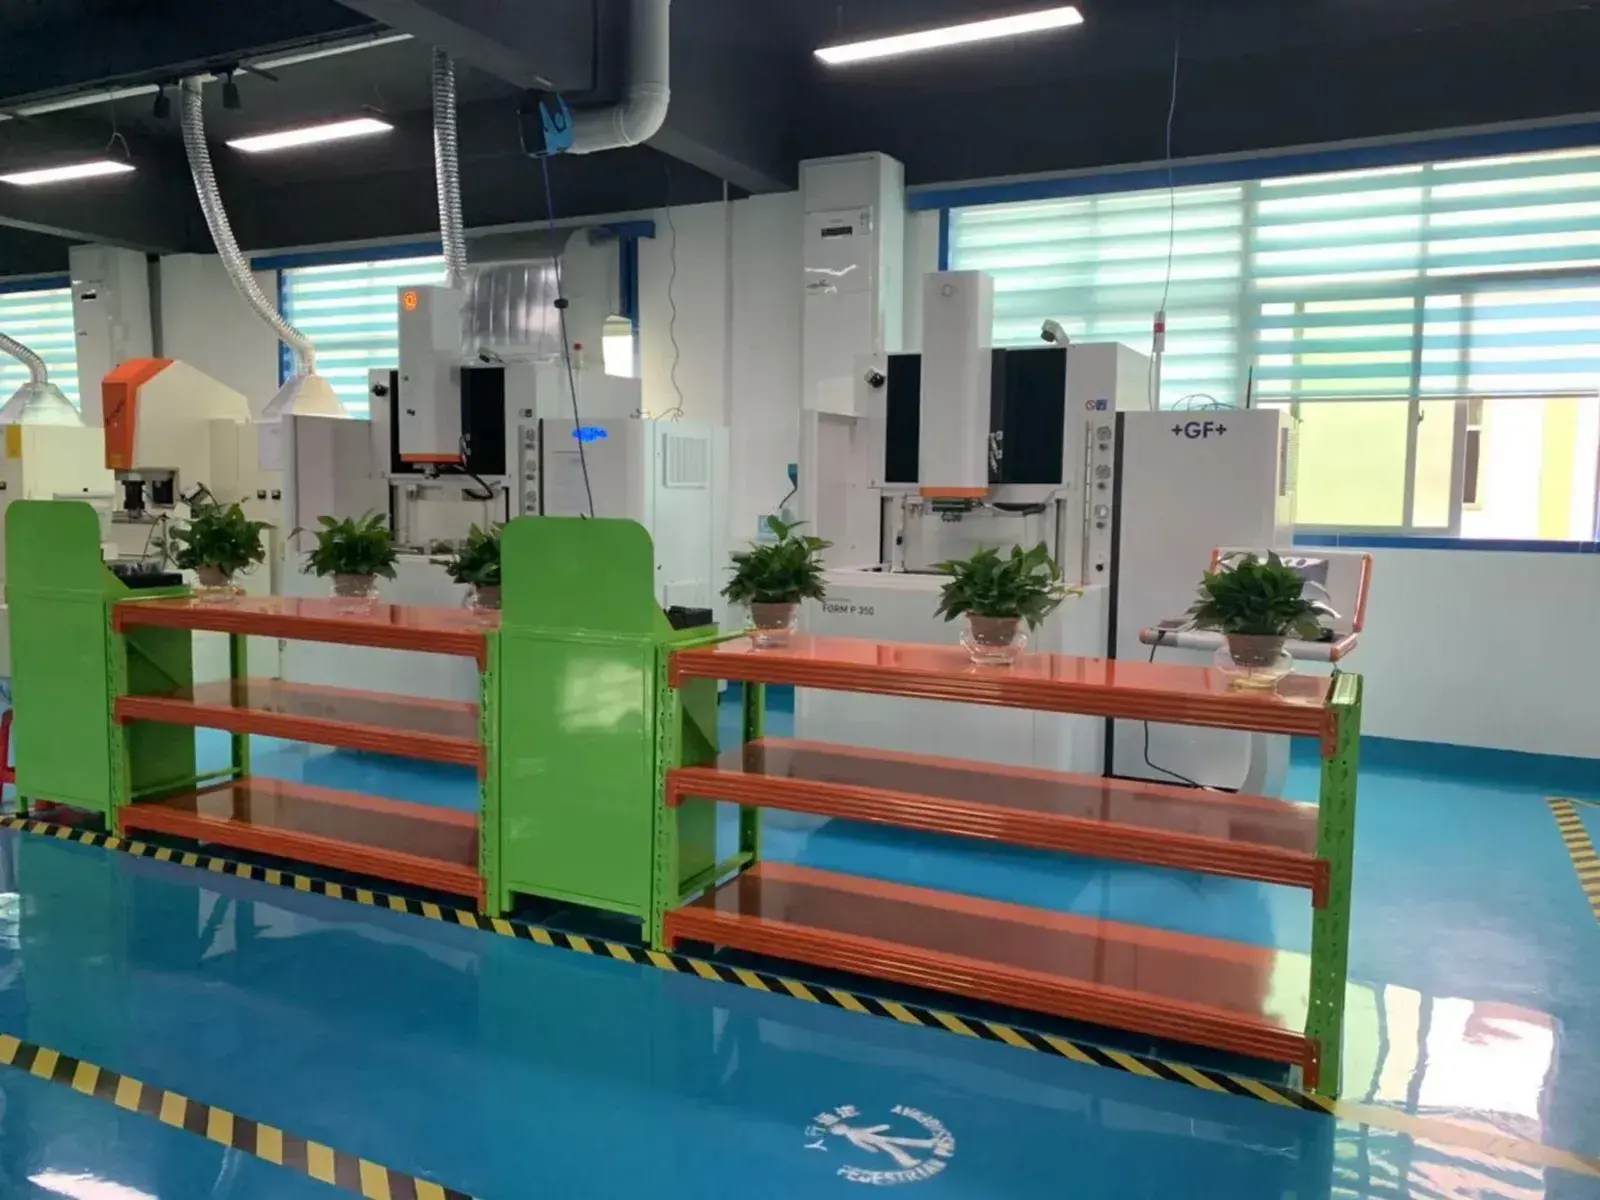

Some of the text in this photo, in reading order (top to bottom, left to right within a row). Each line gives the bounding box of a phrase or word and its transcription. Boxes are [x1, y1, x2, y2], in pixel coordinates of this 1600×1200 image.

[822, 603, 875, 616] FORM P 350
